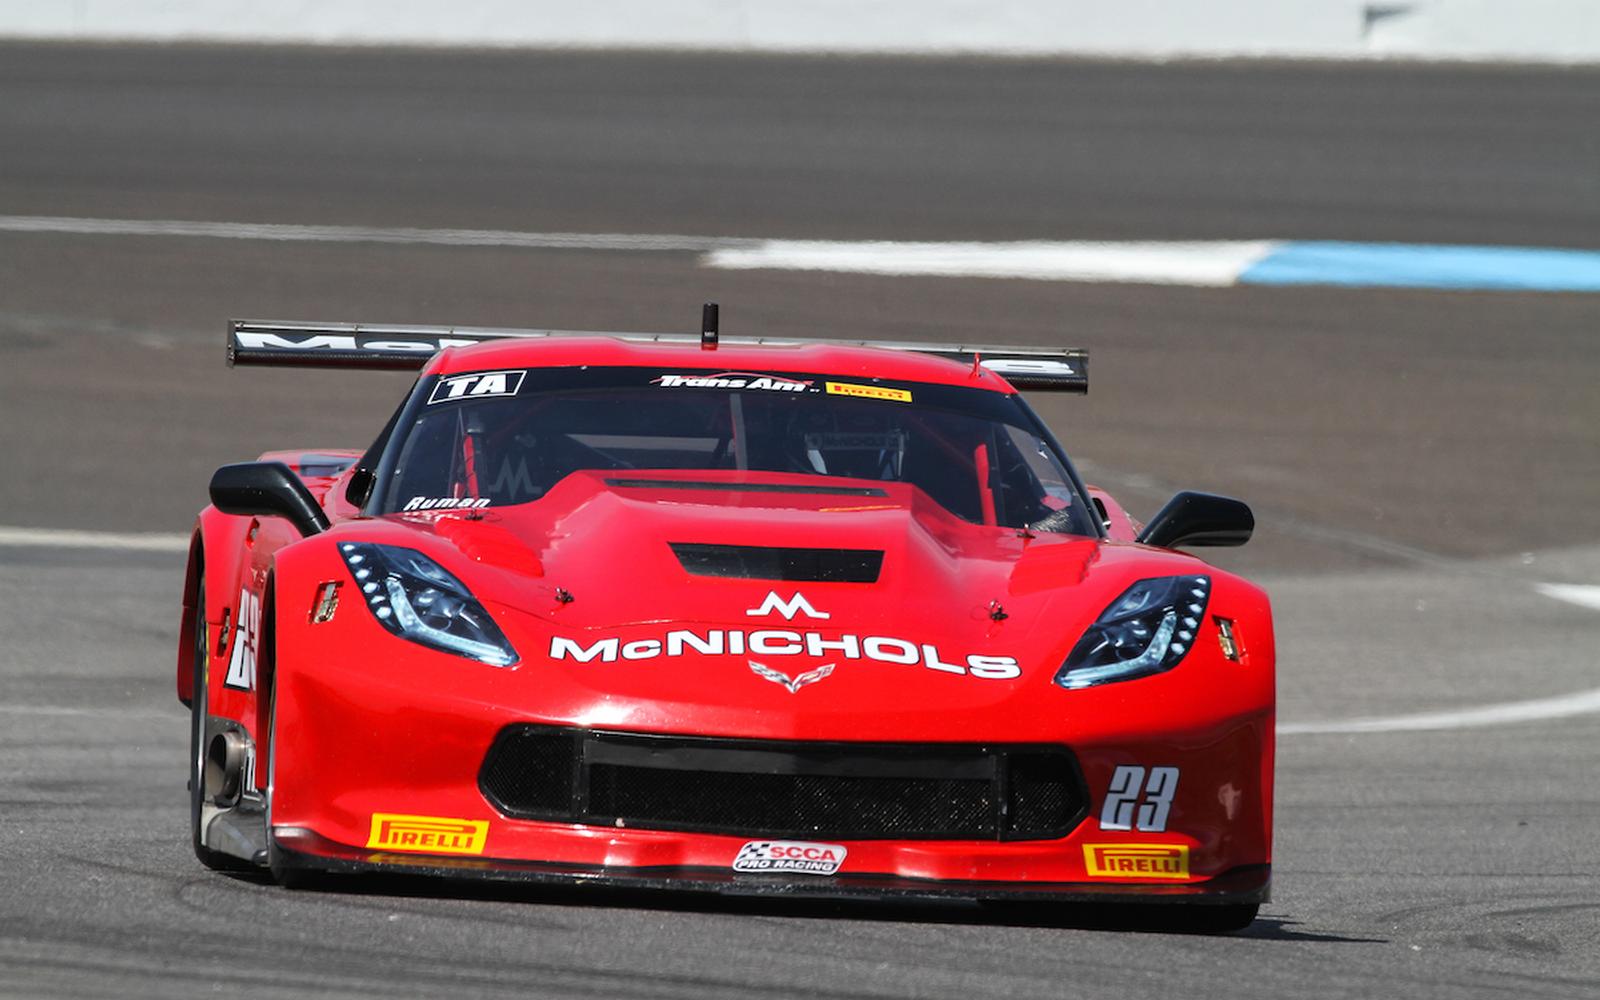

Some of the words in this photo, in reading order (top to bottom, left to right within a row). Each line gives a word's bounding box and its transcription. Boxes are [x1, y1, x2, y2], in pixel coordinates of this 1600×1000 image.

[446, 373, 507, 398] TA
[659, 375, 744, 388] Trans
[746, 377, 807, 393] Am
[402, 496, 492, 511] Ruman
[549, 629, 1023, 680] McNICHOLS
[1099, 765, 1180, 832] 23
[379, 820, 477, 849] PIRELLI
[737, 859, 770, 869] PRO
[773, 860, 834, 872] RACING
[769, 846, 836, 863] SCCA
[1093, 847, 1182, 873] PIRELLI
